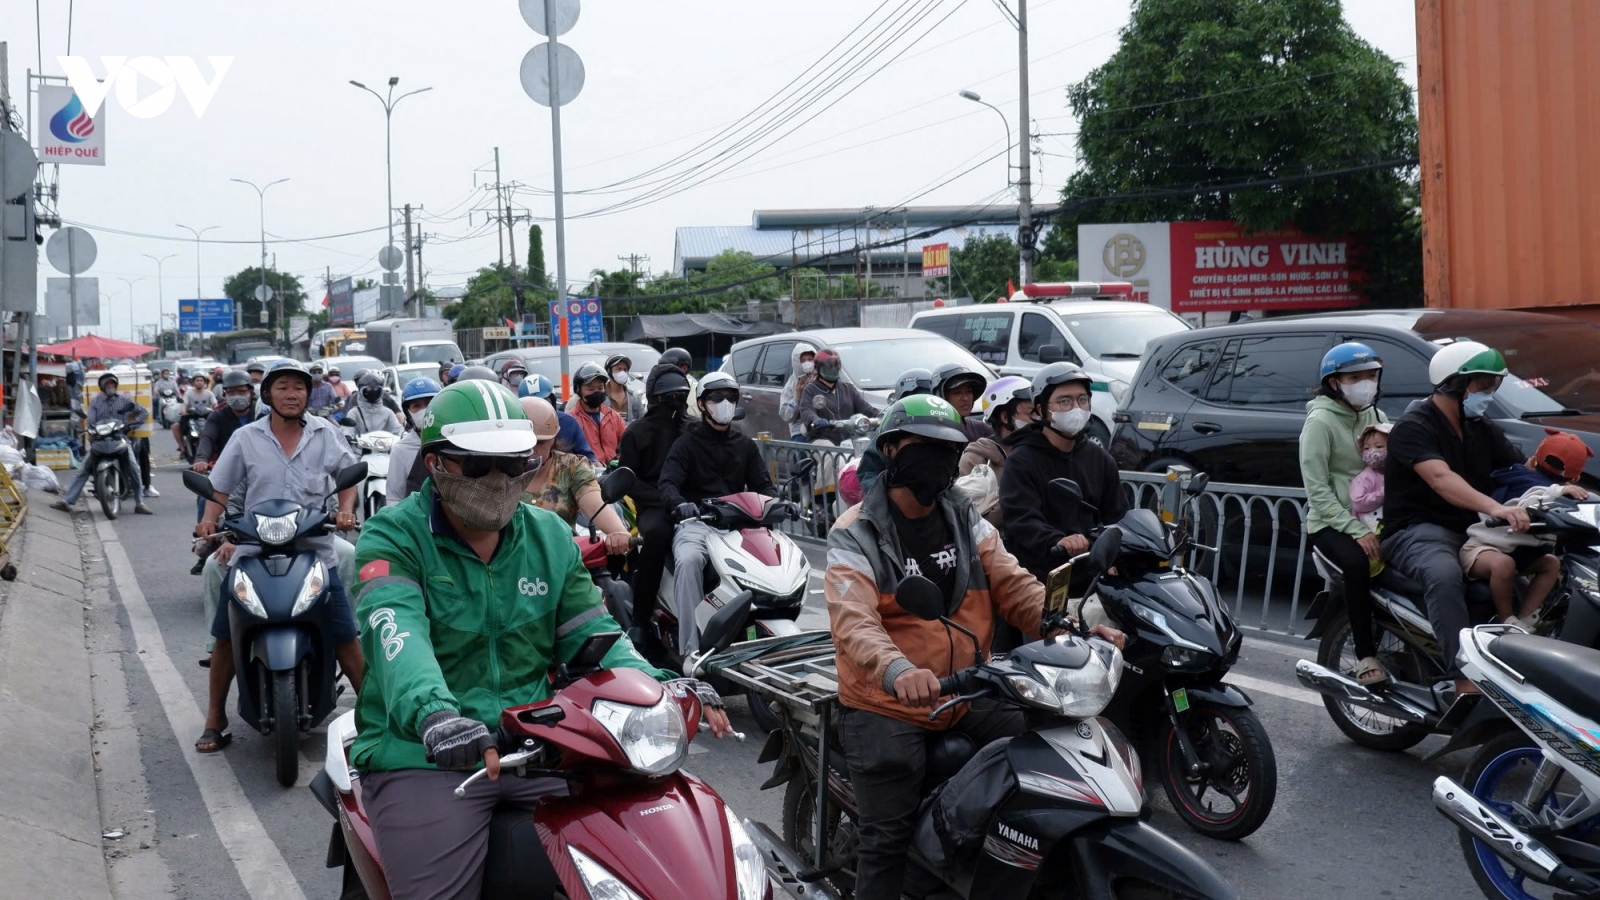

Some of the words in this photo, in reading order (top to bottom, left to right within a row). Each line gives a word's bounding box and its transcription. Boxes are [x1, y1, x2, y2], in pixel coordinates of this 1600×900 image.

[1195, 240, 1269, 268] HÙNG
[1280, 243, 1347, 266] VINH
[929, 409, 949, 417] gojek
[639, 804, 675, 816] HONDA
[998, 822, 1039, 851] YAMAHA
